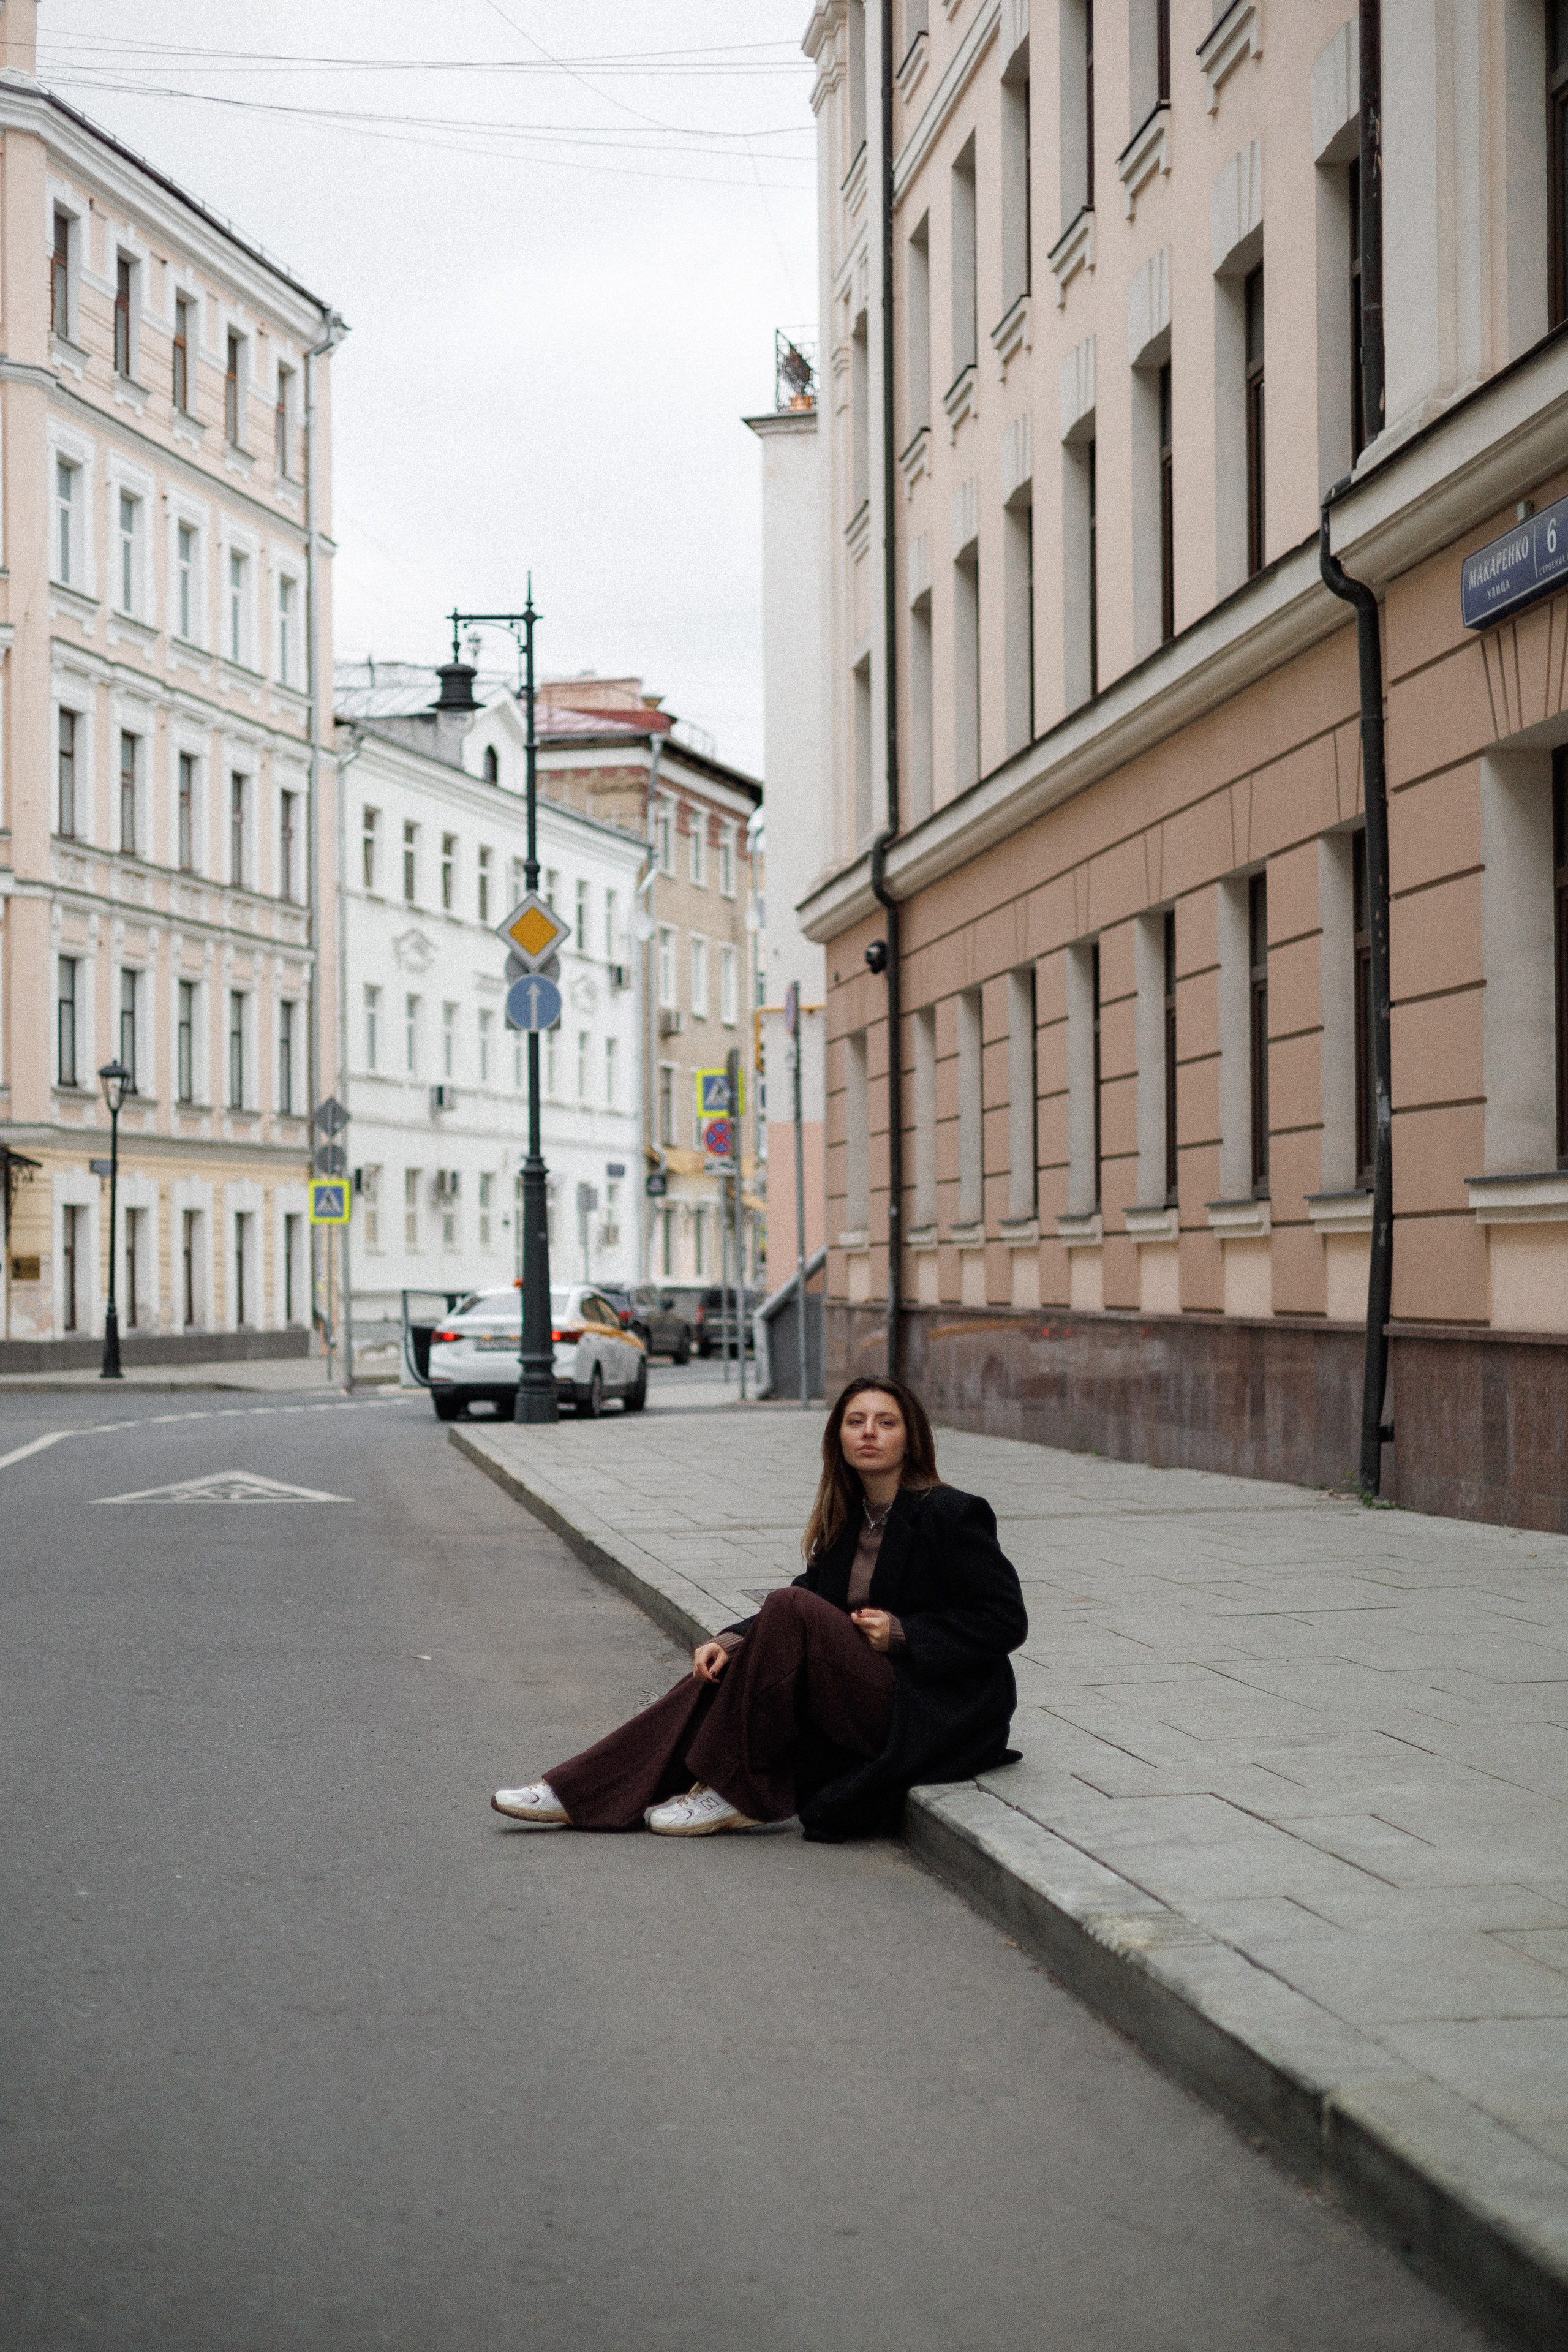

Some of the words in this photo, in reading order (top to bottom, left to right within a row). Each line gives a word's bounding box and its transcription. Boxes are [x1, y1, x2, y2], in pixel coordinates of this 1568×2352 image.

[1547, 518, 1557, 554] 6
[1469, 535, 1529, 591] МАКАРЕНКО
[1487, 579, 1511, 600] УЛИЦА
[699, 1797, 720, 1811] N
